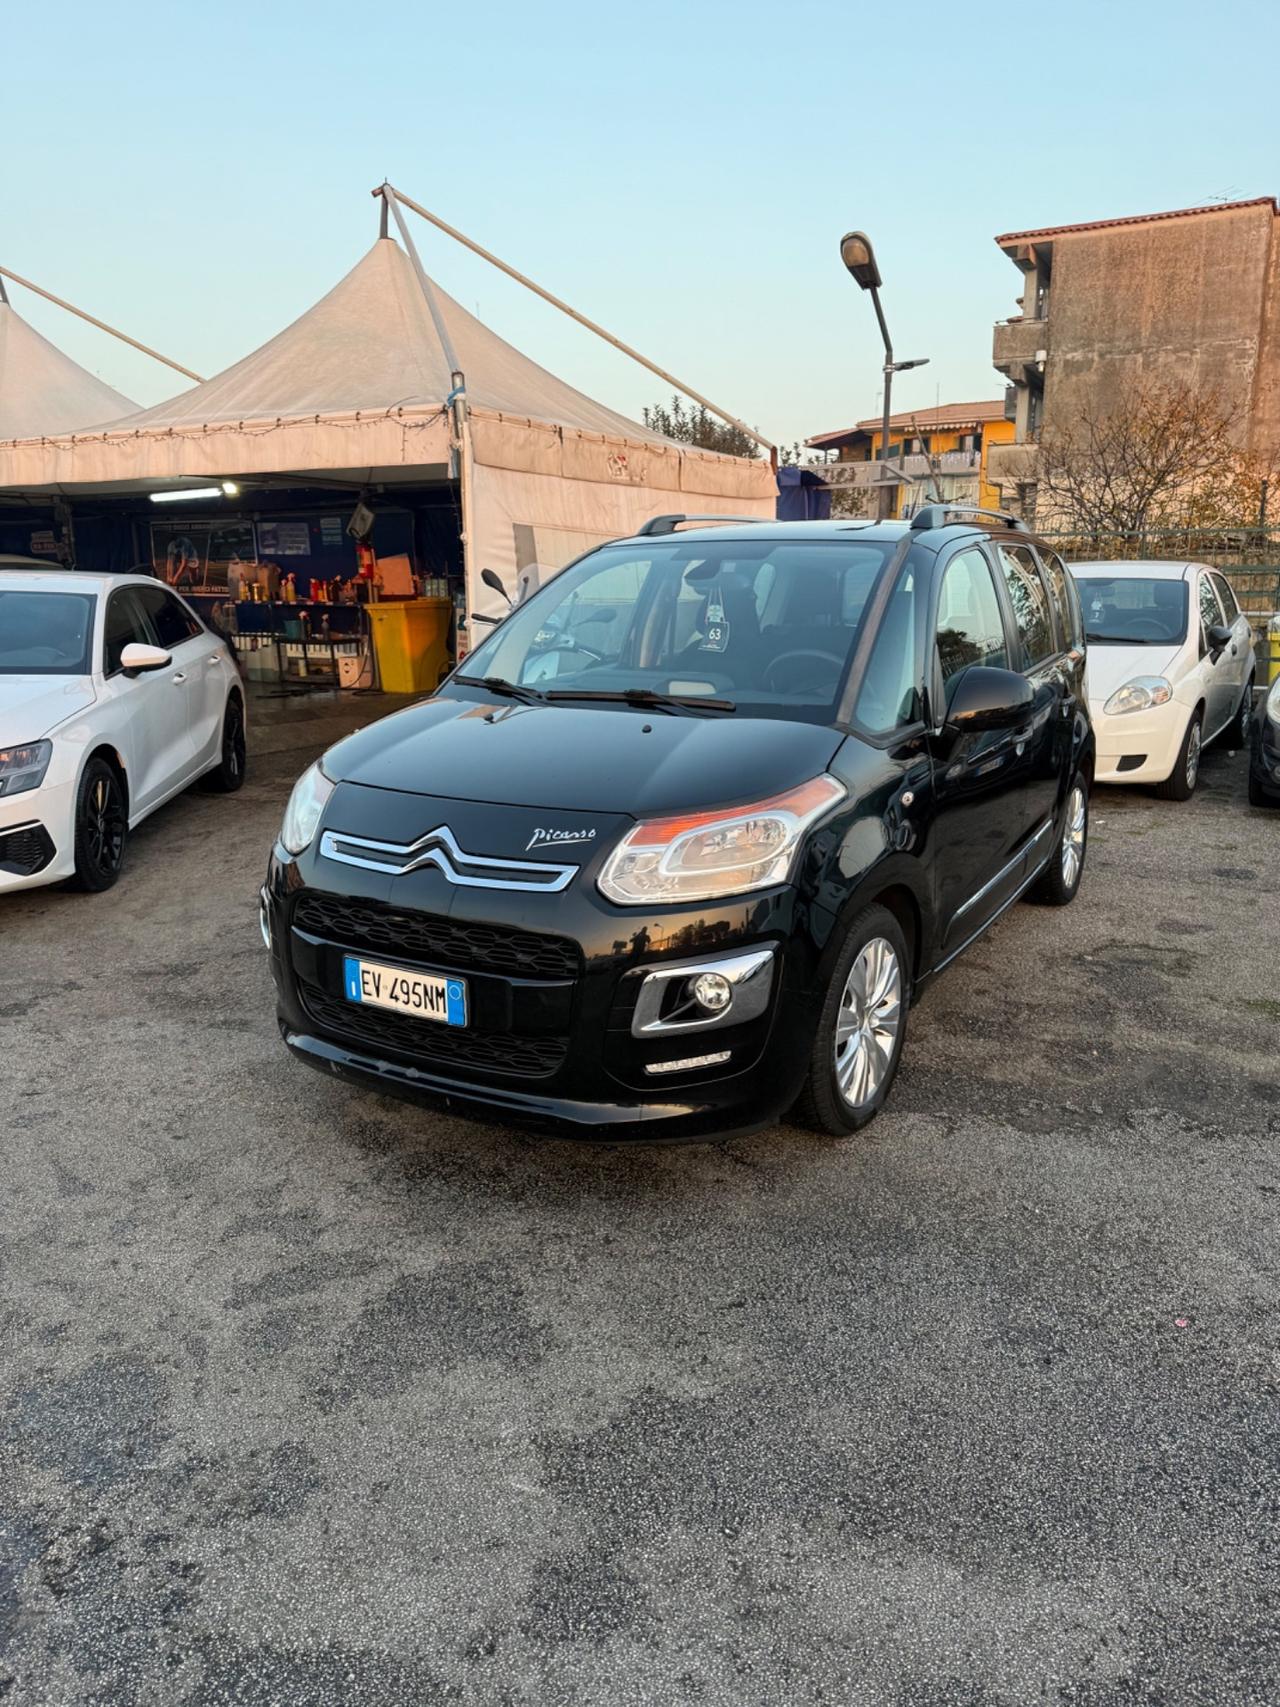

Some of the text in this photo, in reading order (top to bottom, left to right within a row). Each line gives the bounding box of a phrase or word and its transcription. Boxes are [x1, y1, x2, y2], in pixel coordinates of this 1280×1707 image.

[708, 628, 721, 640] 63
[525, 828, 597, 851] Picasso
[361, 970, 447, 1013] EV 495NM
